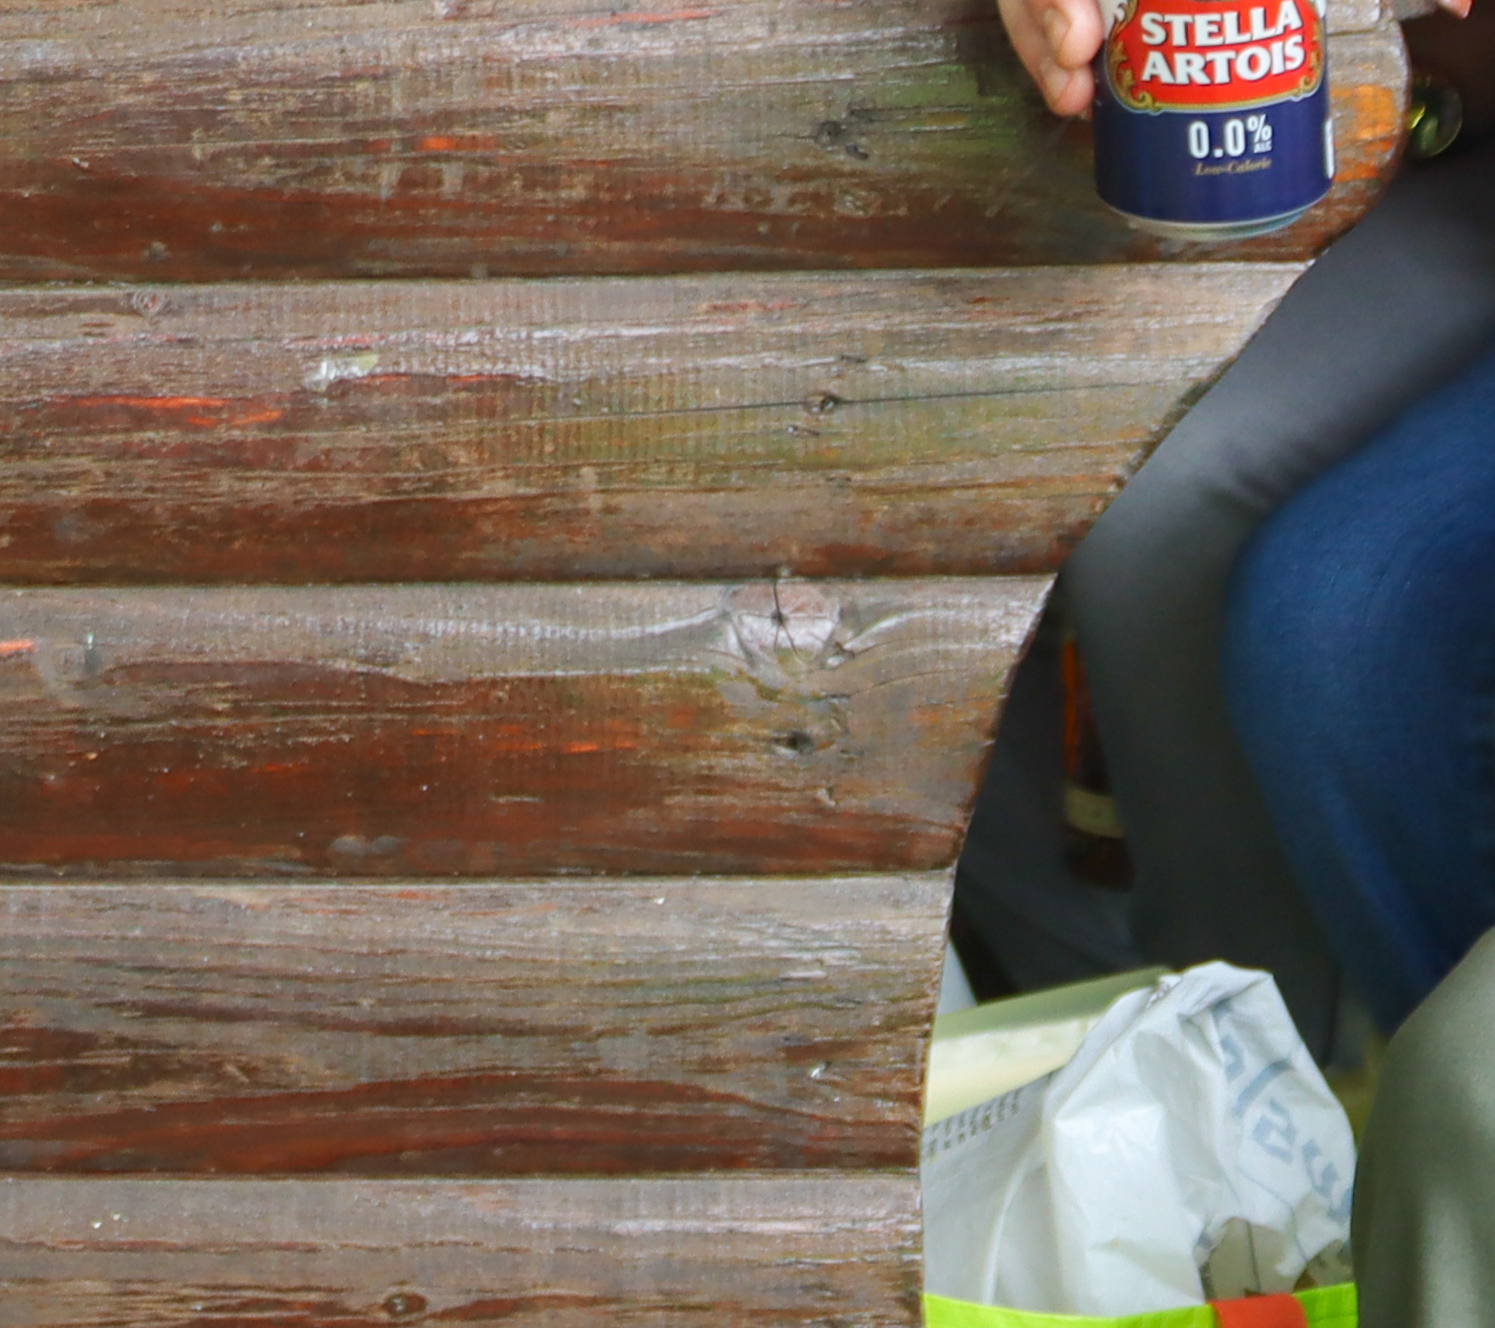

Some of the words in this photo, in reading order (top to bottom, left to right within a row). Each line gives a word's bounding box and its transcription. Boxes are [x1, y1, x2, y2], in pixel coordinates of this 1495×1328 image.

[1141, 34, 1306, 86] ARTOIS
[1188, 113, 1272, 160] 0.0%
[1253, 141, 1272, 154] ALC
